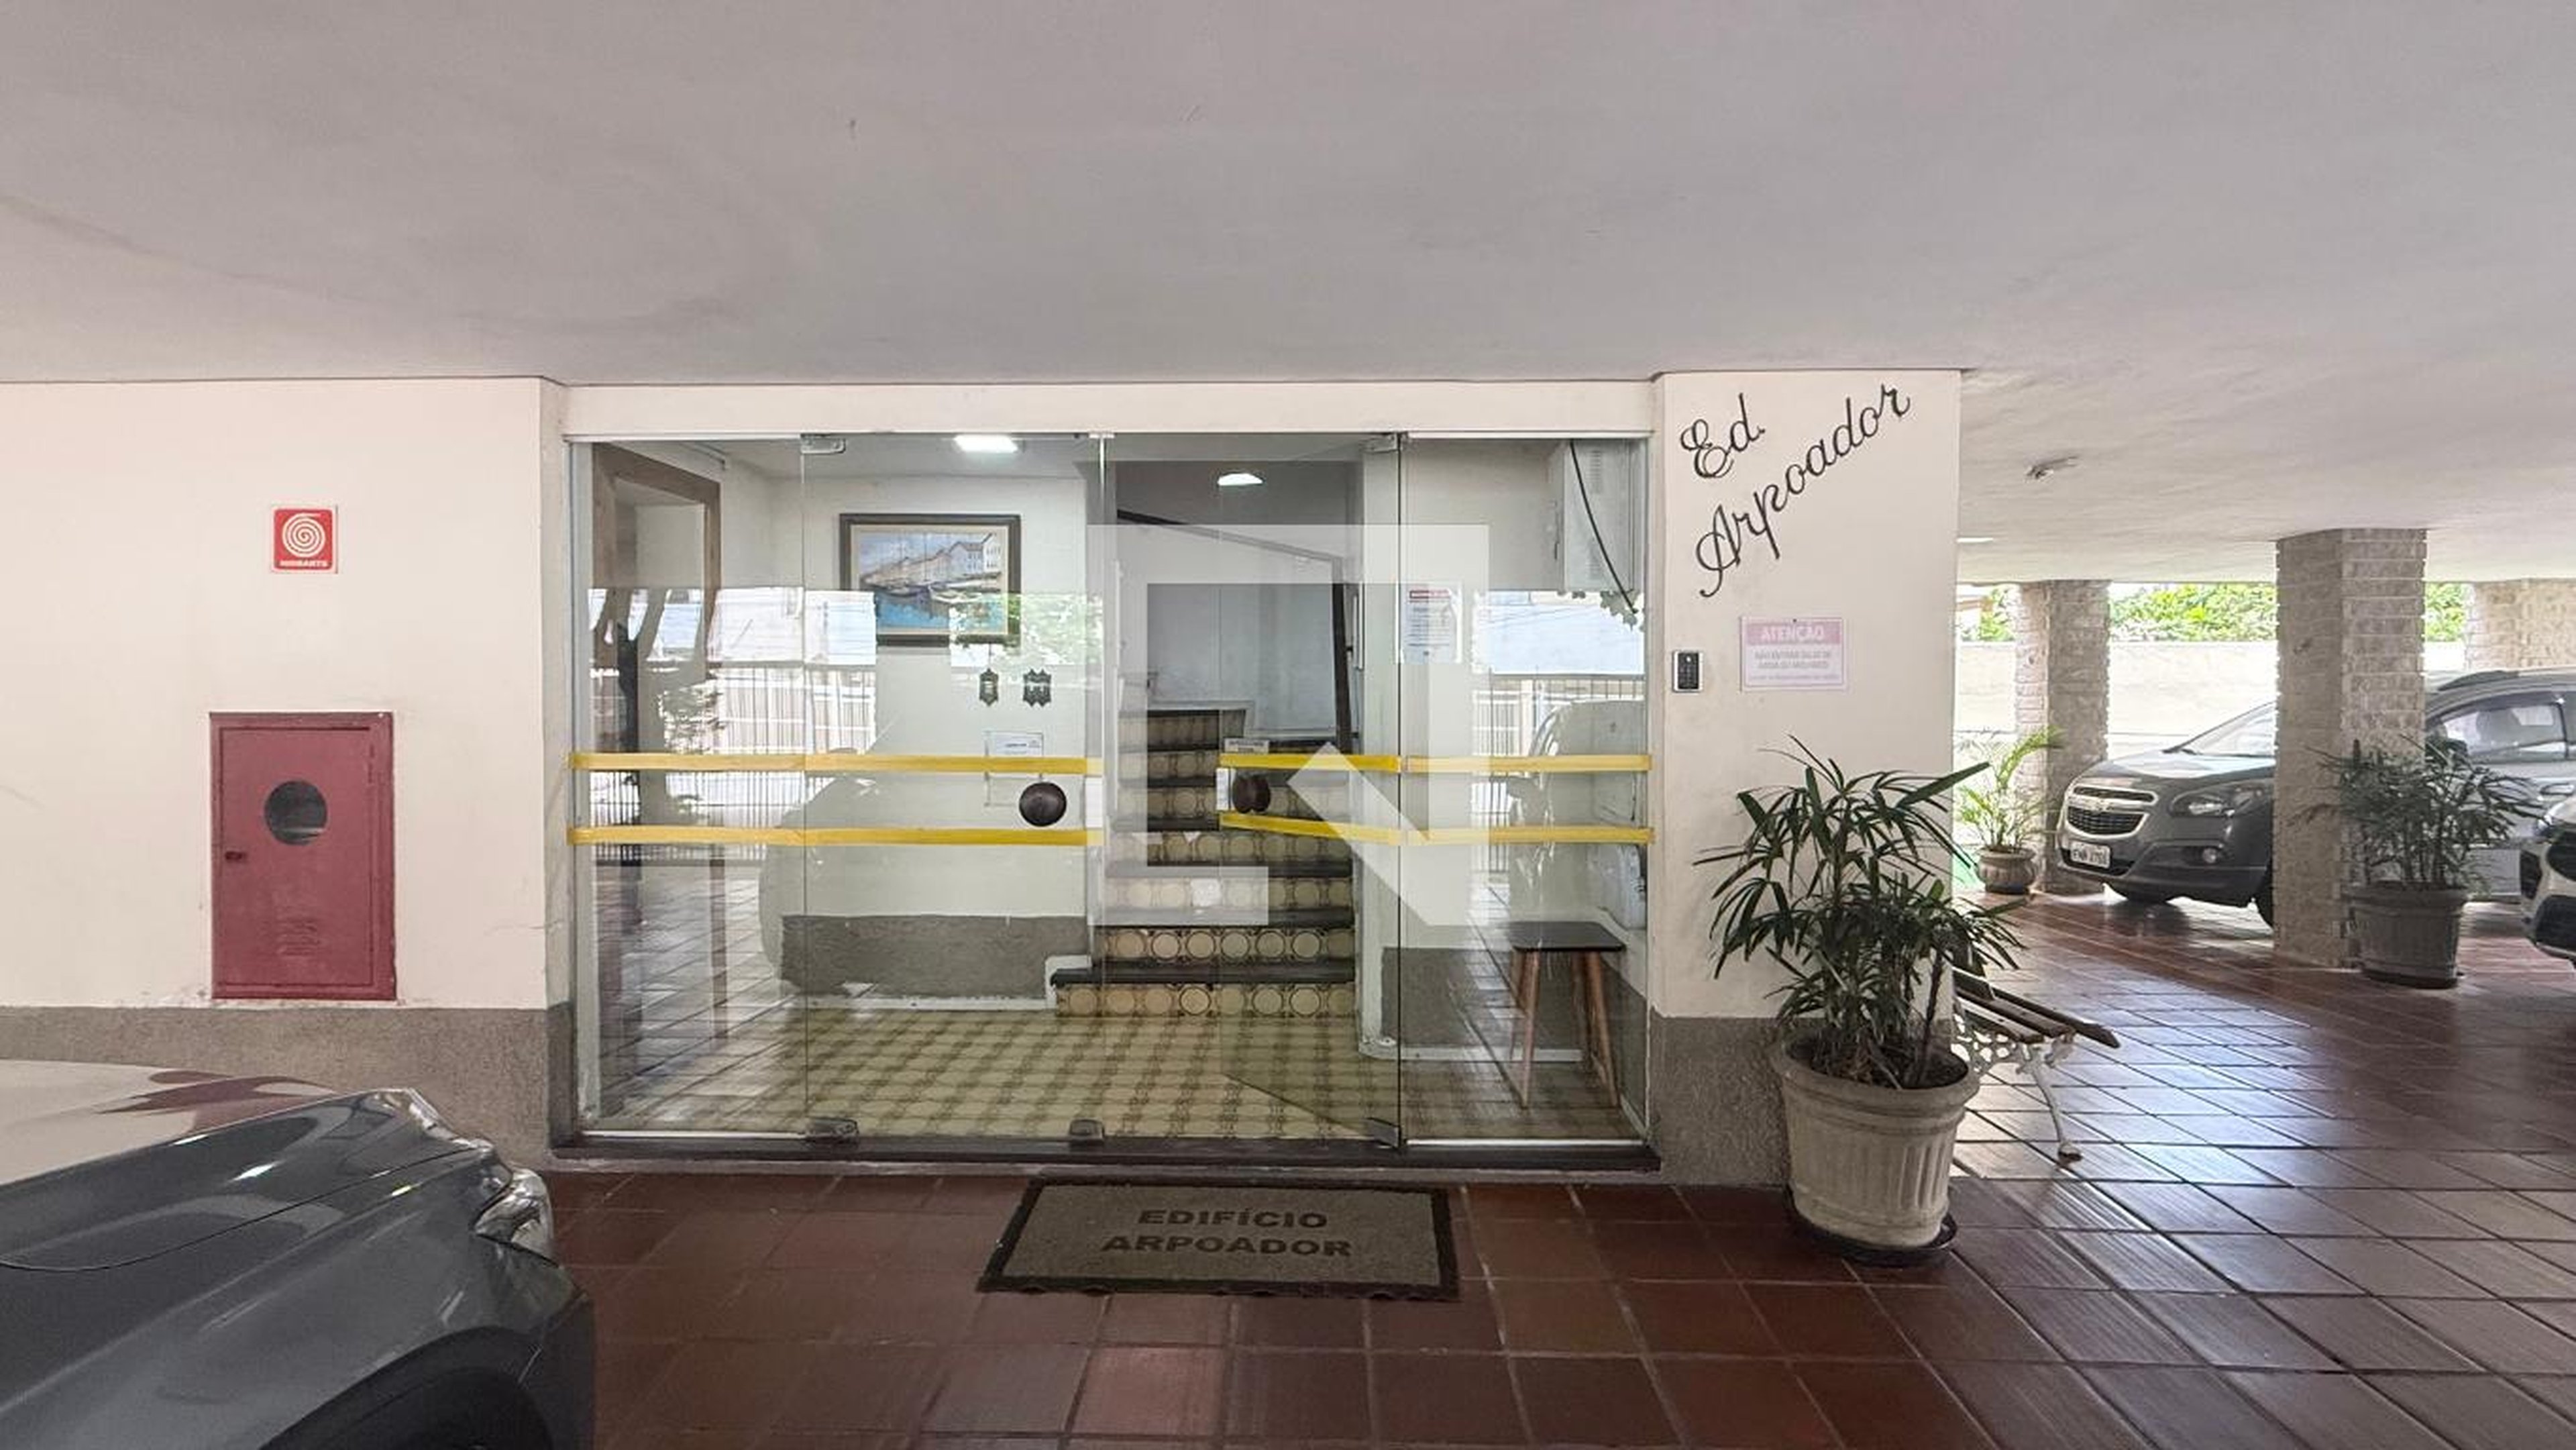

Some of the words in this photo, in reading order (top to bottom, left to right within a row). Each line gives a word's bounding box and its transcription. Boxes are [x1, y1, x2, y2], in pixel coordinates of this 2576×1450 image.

[1680, 392, 1766, 478] Ed.
[1696, 383, 1911, 598] Arpoador
[1760, 623, 1825, 641] ATENÇÃO
[1138, 1208, 1327, 1228] EDIFÍCIO
[1100, 1236, 1352, 1257] ARPOADOR
